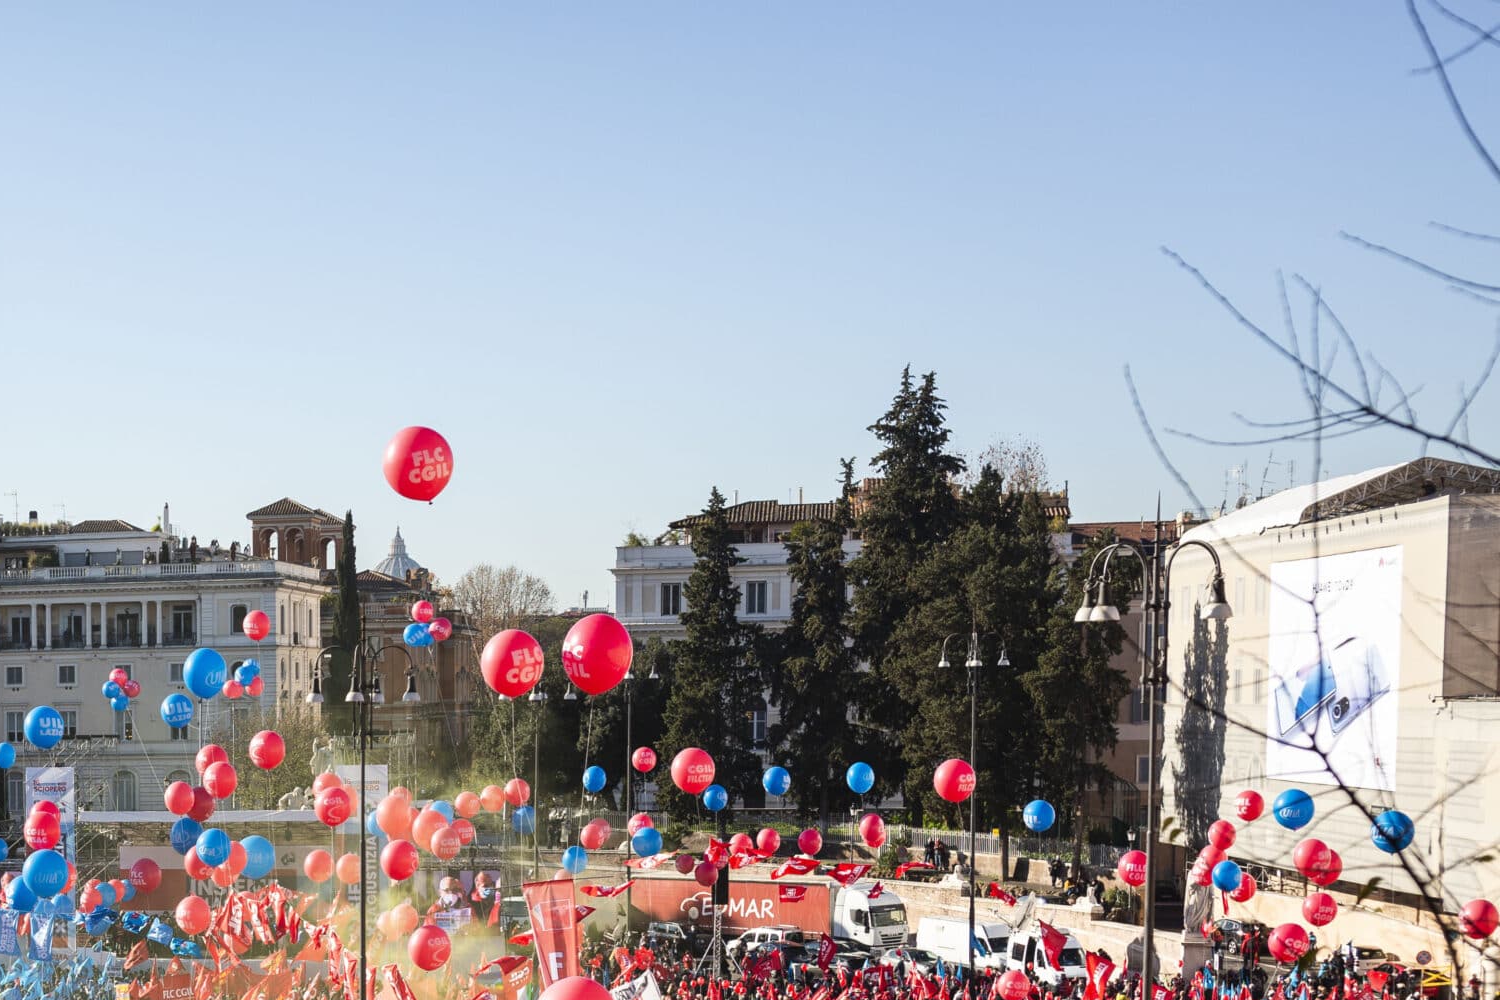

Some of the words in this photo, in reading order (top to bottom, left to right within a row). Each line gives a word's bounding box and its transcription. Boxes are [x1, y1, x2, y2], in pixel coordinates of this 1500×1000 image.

[412, 447, 444, 467] FLC
[408, 465, 450, 484] CGIL
[39, 717, 64, 729] UIL
[162, 988, 175, 999] FLC
[176, 987, 194, 998] CGIL
